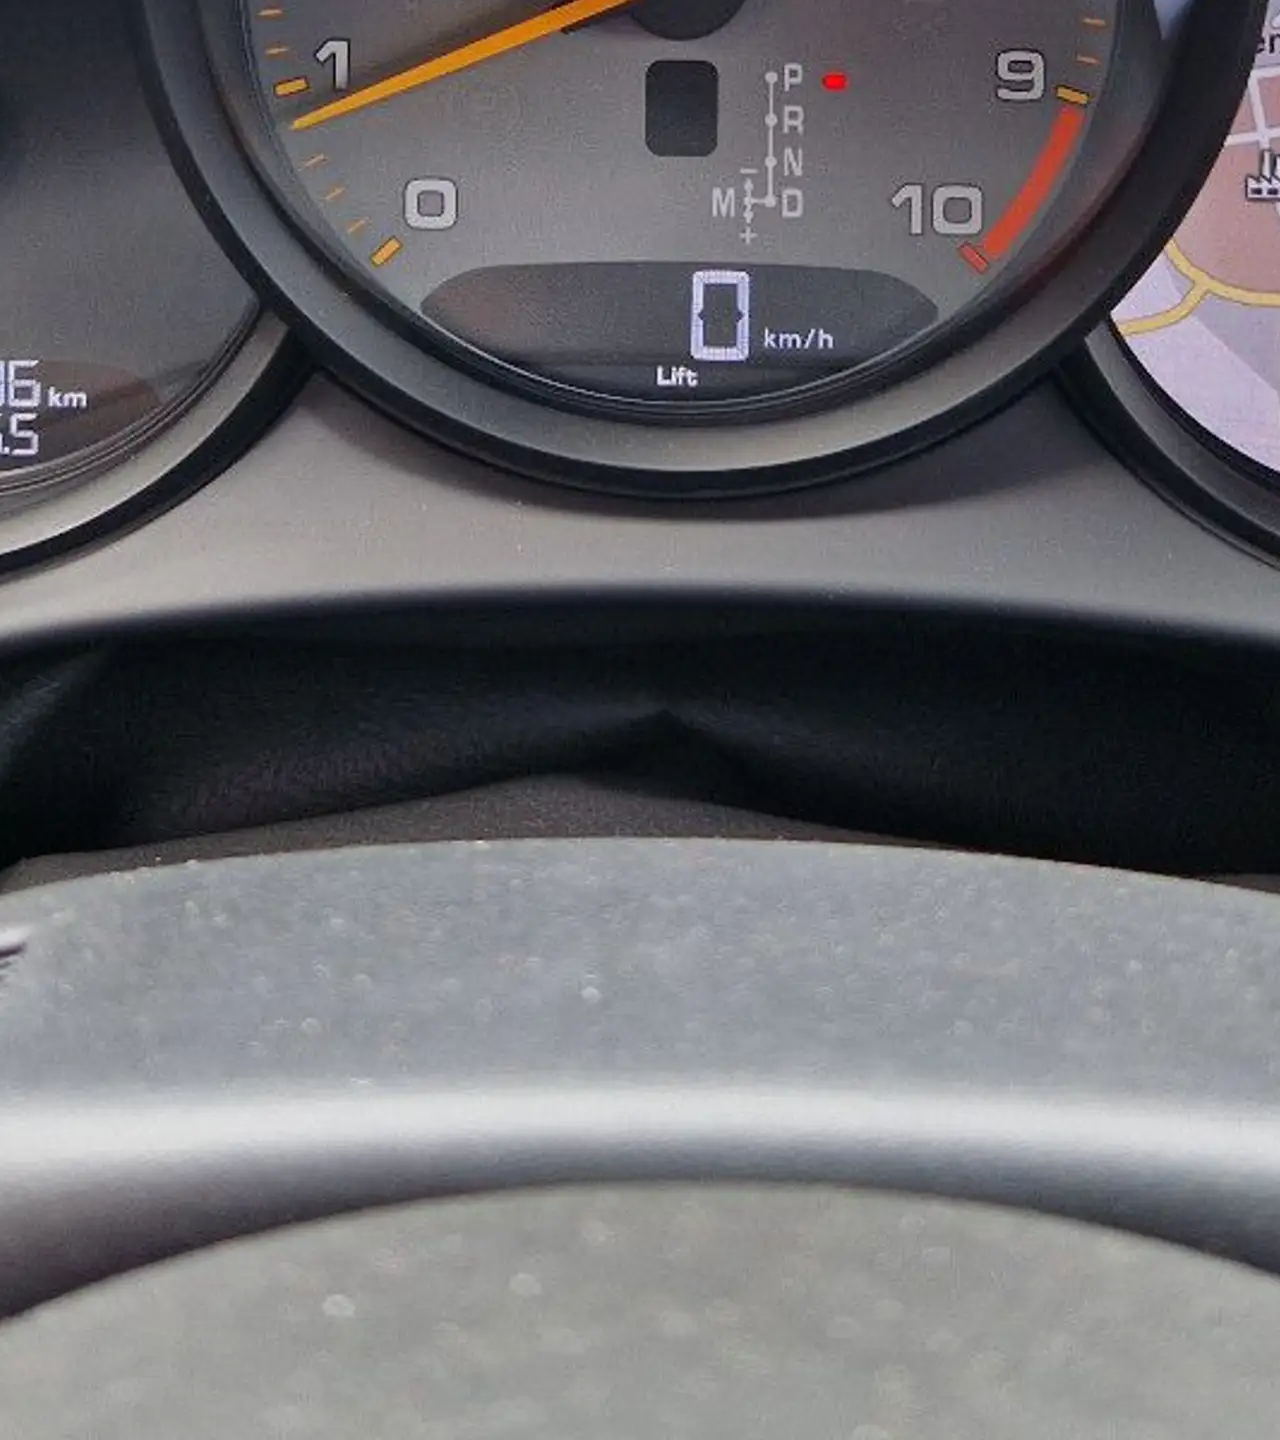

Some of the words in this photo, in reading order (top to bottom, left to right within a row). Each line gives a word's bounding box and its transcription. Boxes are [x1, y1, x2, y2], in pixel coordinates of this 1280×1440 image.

[315, 38, 351, 91] 1
[783, 63, 803, 92] P
[995, 48, 1046, 102] 9
[783, 105, 804, 134] R
[783, 147, 803, 176] N
[403, 177, 458, 231] 0
[711, 187, 735, 217] M
[781, 188, 804, 218] D
[891, 183, 983, 235] 10
[690, 269, 750, 362] 0
[763, 327, 834, 349] km/h
[656, 365, 698, 386] Lift
[47, 386, 87, 408] km
